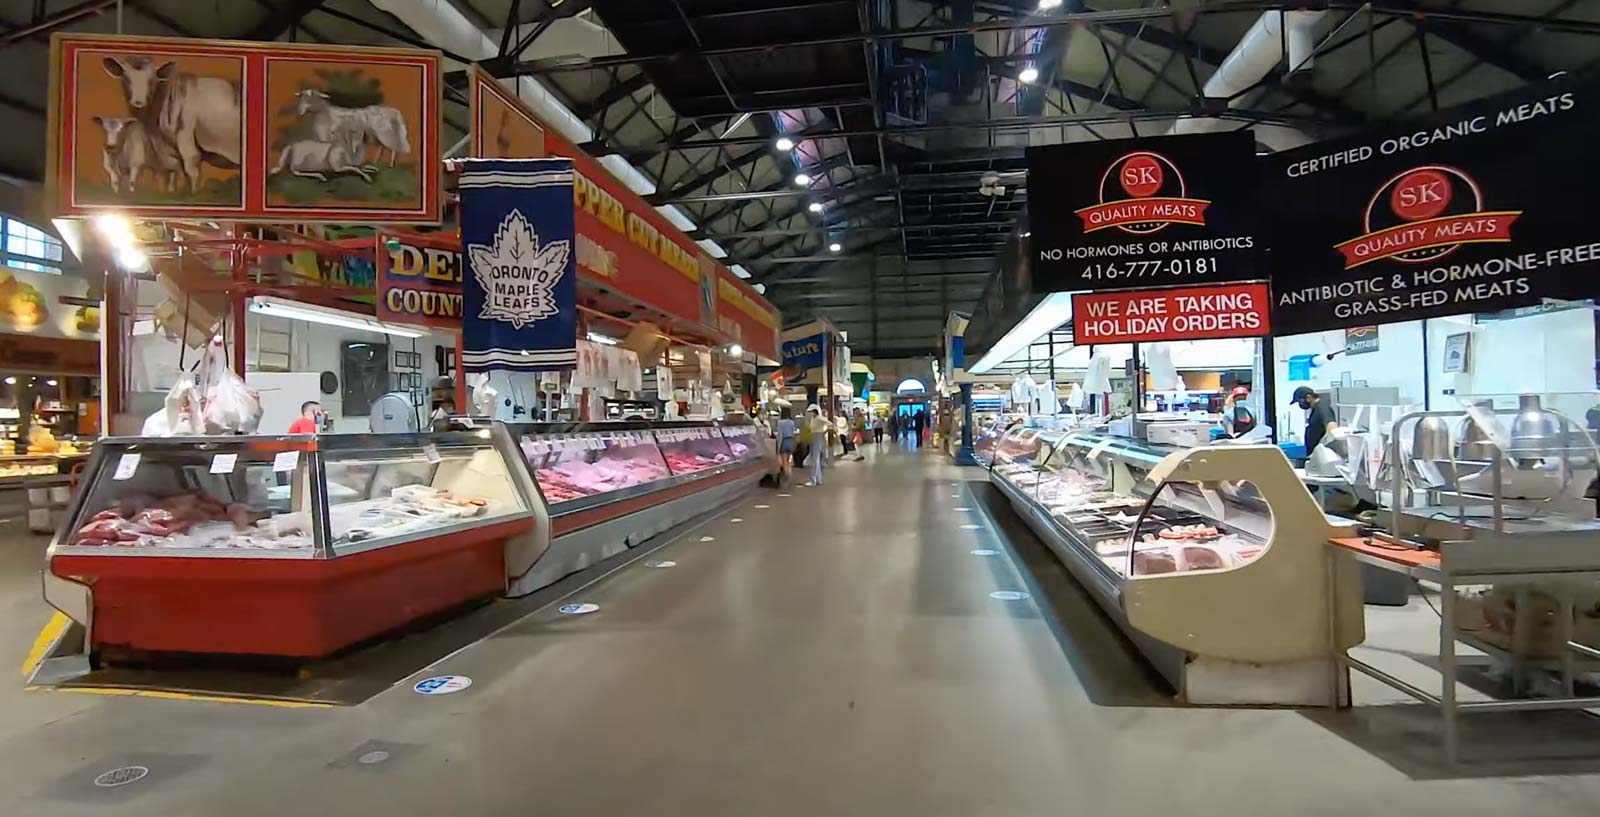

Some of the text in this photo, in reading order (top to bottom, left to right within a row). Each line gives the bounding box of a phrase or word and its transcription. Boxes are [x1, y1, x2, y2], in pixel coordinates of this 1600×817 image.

[1286, 93, 1574, 177] CERTIFIED ORGANIC MEATS
[1125, 166, 1157, 185] SK
[573, 168, 624, 233] PPER
[1400, 181, 1443, 207] SK
[1089, 204, 1196, 224] QUALITY MEATS
[1041, 236, 1254, 260] NO HORMONES OR ANTIBIOTICS
[1354, 218, 1497, 257] QUALITY MEATS
[1081, 257, 1217, 280] 416-777-0181
[1279, 242, 1600, 306] ANTIBIOTIC & HORMONE-FREE
[494, 282, 539, 297] MAPLE
[494, 295, 540, 309] LEAFS
[1335, 277, 1530, 318] GRASS-FED MEATS
[1086, 293, 1253, 318] WE ARE TAKING
[1084, 311, 1260, 337] HOLIDAY ORDERS
[784, 342, 820, 359] uture
